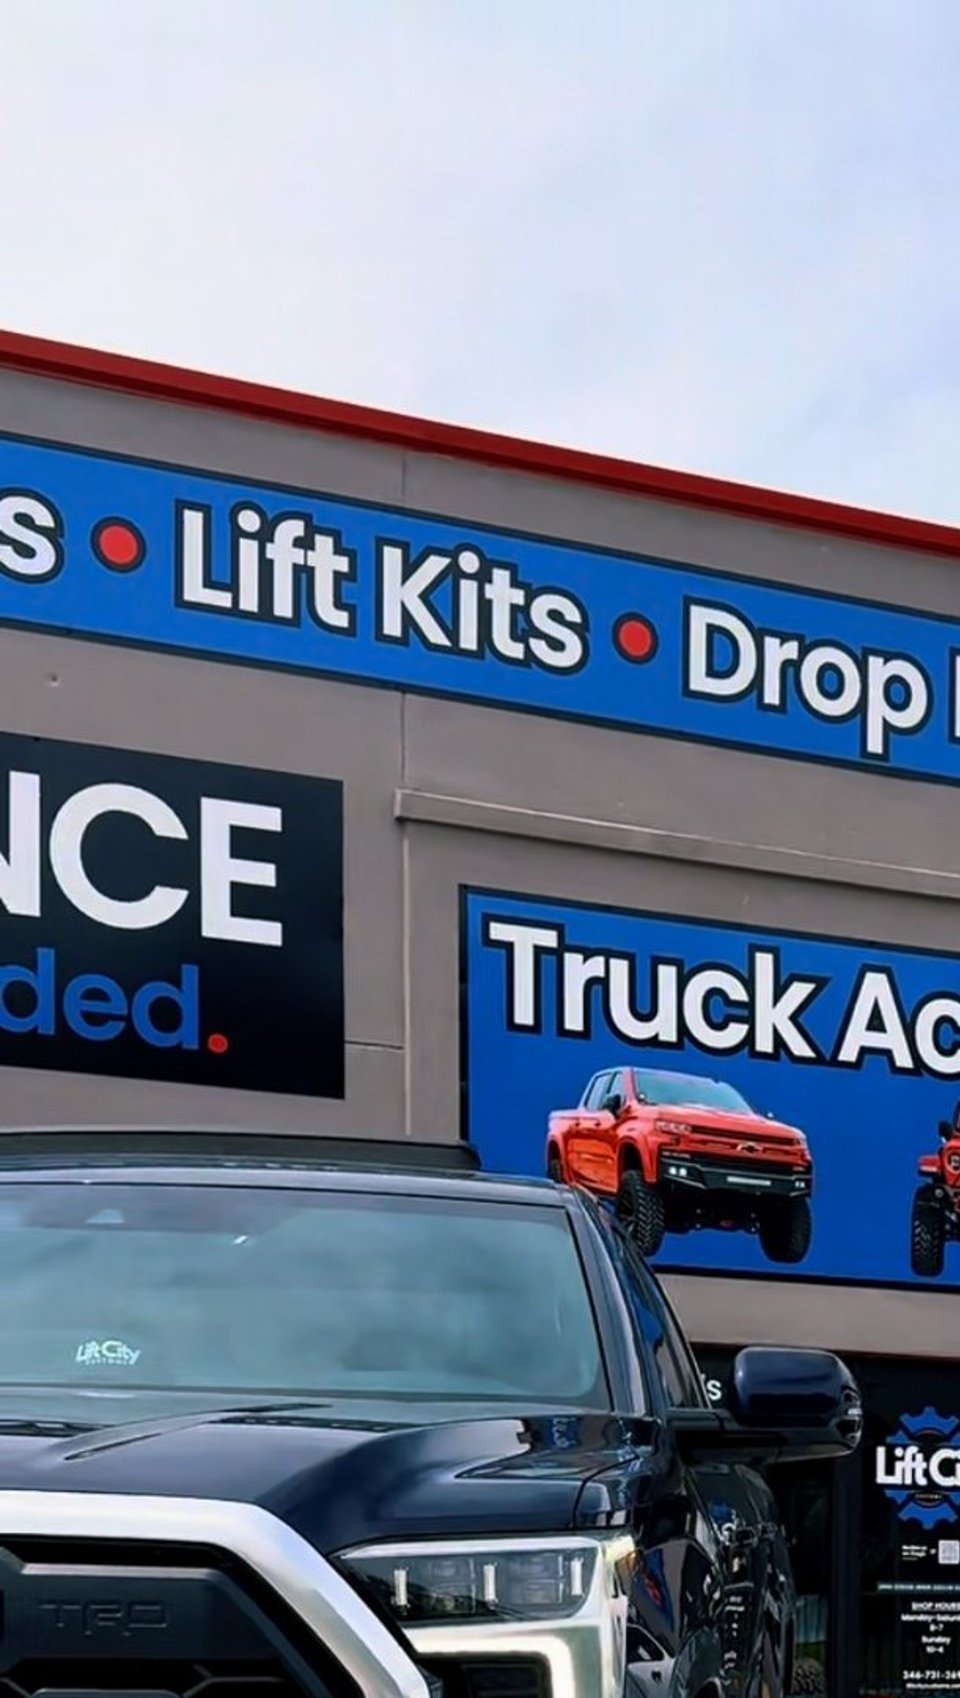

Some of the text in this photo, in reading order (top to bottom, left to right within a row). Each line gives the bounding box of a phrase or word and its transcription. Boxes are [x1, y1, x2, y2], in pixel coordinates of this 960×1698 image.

[182, 508, 350, 629] Lift
[382, 544, 584, 669] Kits
[688, 603, 929, 756] Drop
[488, 920, 818, 1060] Truck
[876, 1445, 928, 1486] Lift
[37, 1603, 168, 1637] TRD
